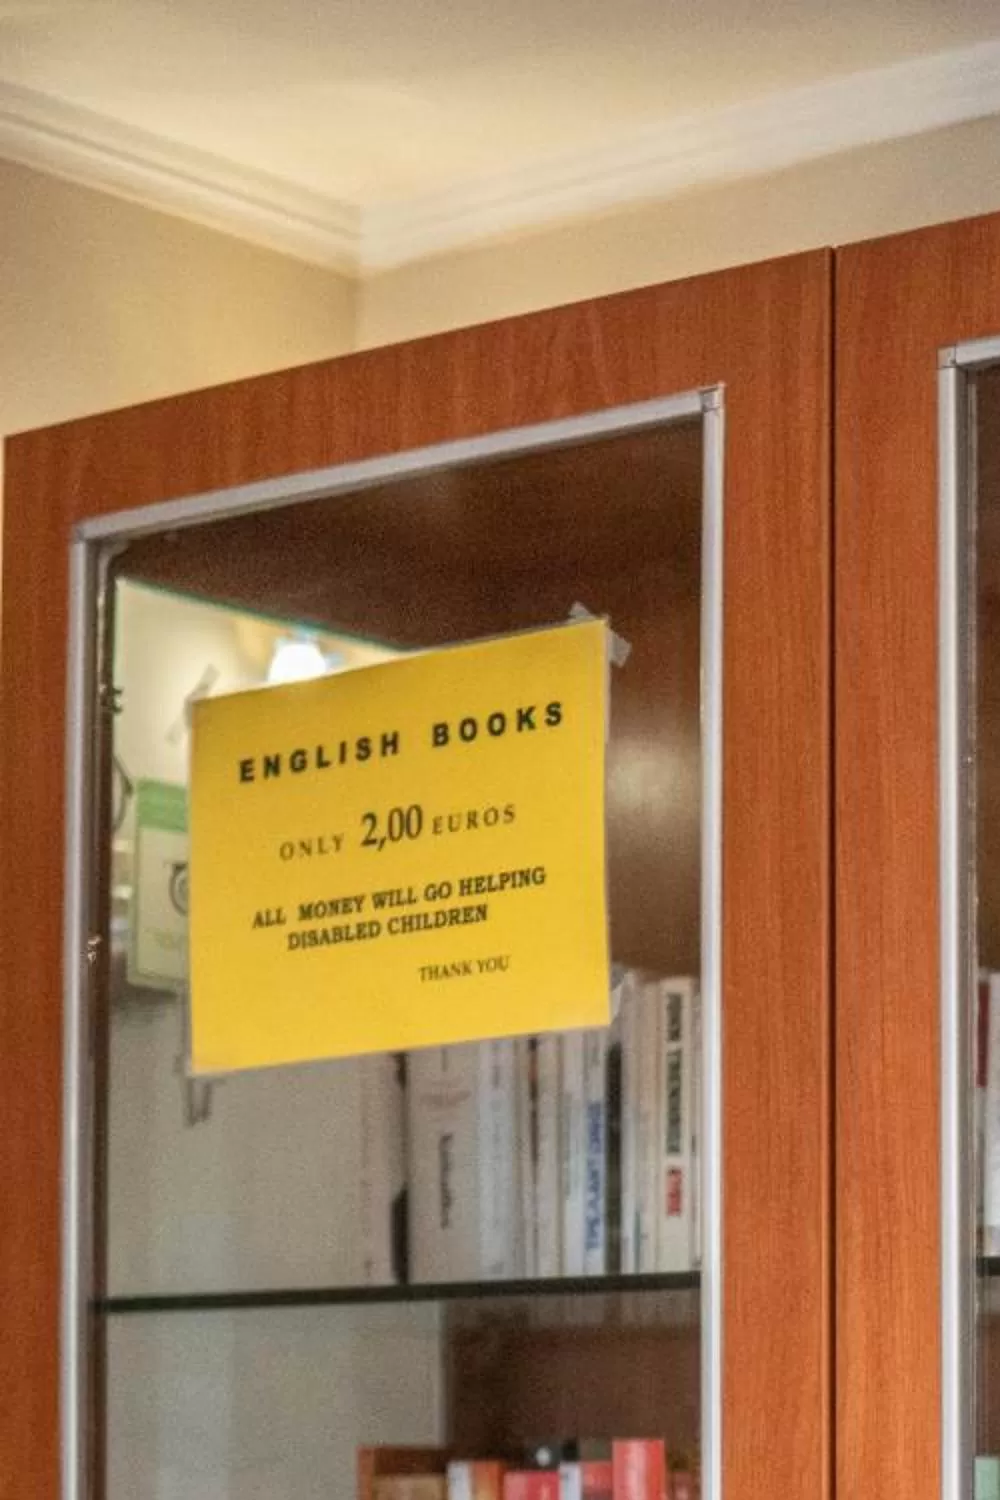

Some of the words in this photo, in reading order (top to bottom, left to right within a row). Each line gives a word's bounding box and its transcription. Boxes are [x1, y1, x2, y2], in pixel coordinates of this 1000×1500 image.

[239, 731, 399, 783] ENGLISH
[432, 701, 562, 748] BOOKS
[280, 833, 344, 861] ONLY
[360, 804, 423, 851] 2,00
[432, 804, 515, 836] EUROS
[252, 907, 286, 928] ALL
[299, 894, 365, 921] MONEY
[372, 887, 418, 910] WILL
[424, 881, 452, 901] GO
[459, 866, 546, 897] HELPING
[286, 919, 382, 950] DISABLED
[387, 903, 488, 935] CHILDREN
[419, 960, 472, 982] THANK
[476, 955, 509, 973] YOU
